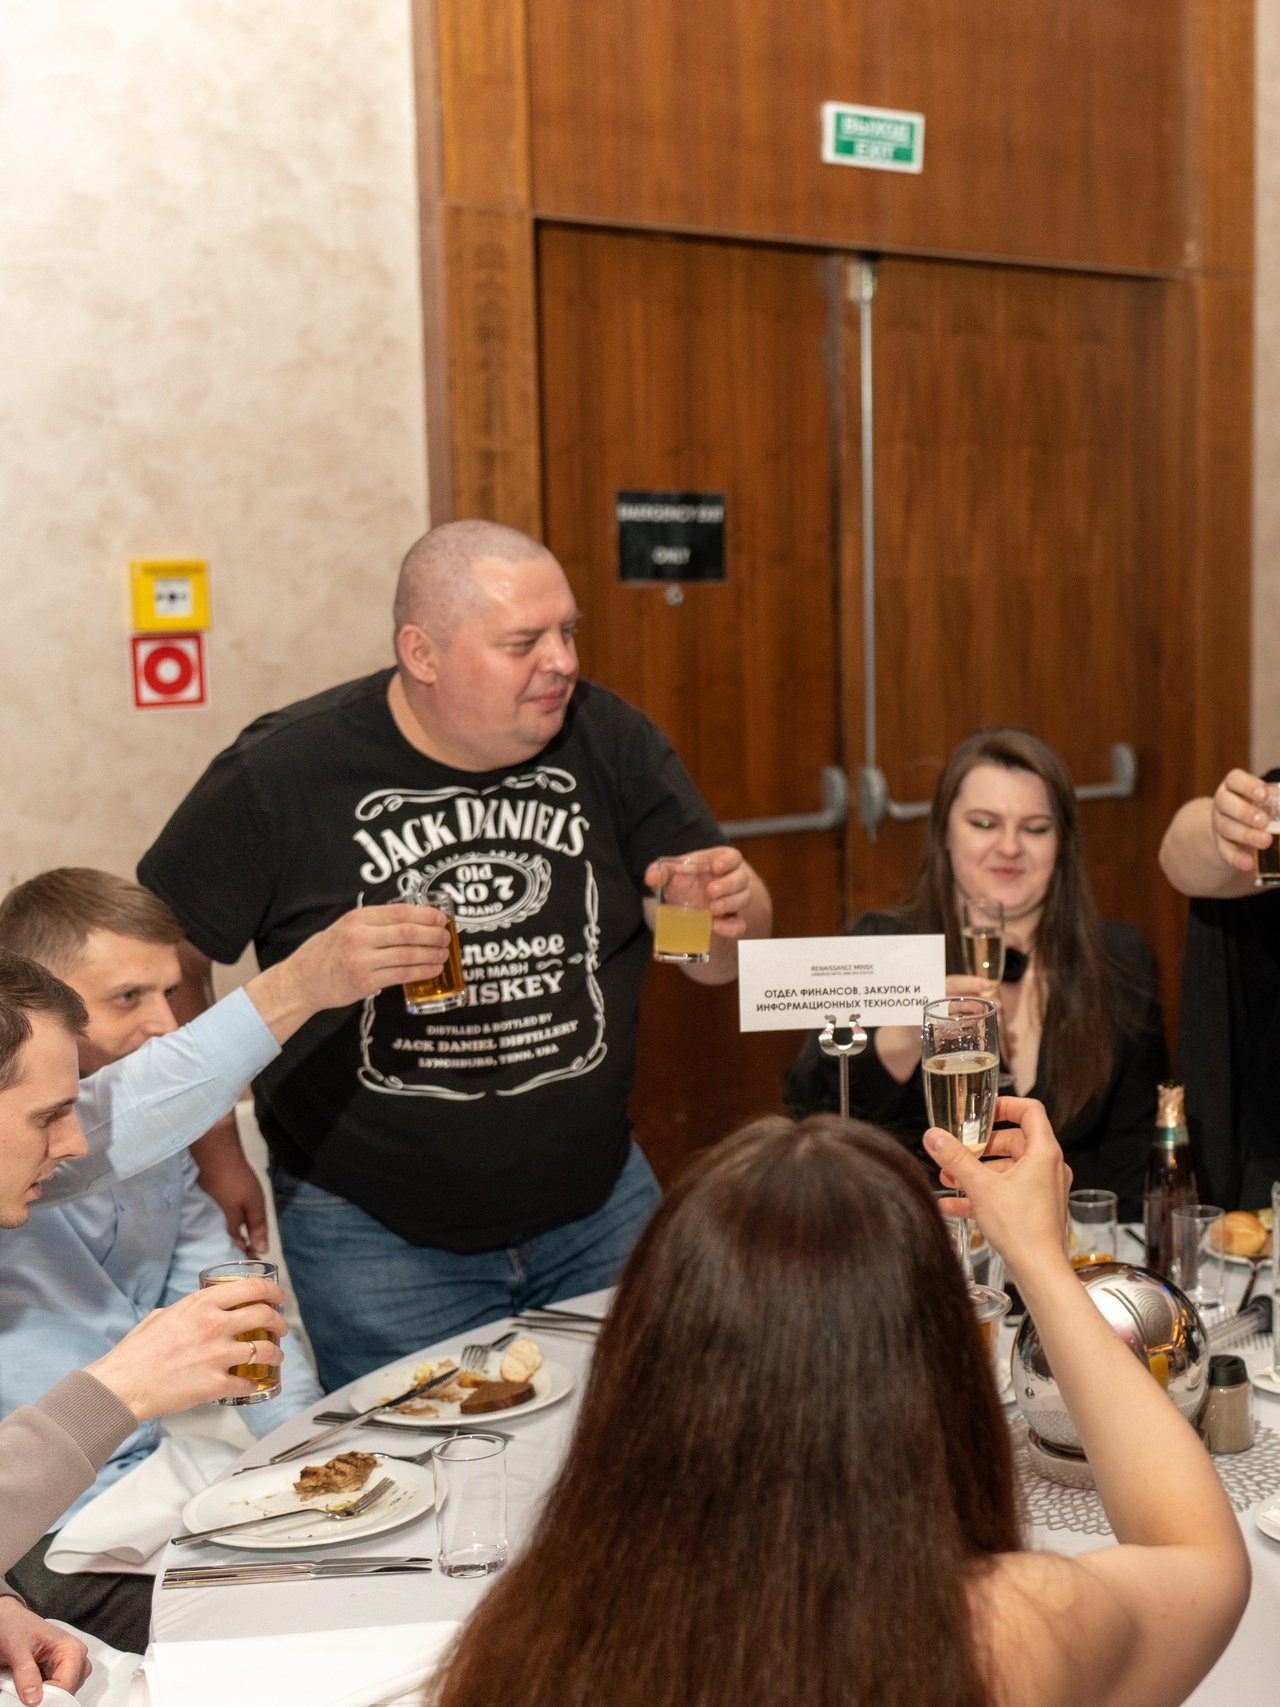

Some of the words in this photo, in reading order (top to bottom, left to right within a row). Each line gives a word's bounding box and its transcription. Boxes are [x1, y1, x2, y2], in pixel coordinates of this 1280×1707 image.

[353, 811, 457, 884] JACK
[455, 798, 590, 857] DANIEL'S
[456, 863, 493, 882] Old
[492, 875, 514, 900] 7
[457, 902, 503, 916] BRAND
[461, 933, 565, 966] nessee
[464, 967, 486, 982] UR
[486, 961, 529, 978] MASH
[467, 969, 565, 1007] ISKEY
[764, 989, 798, 999] ОТДЕЛ
[800, 986, 861, 997] ФИНАНСОВ,
[864, 985, 911, 995] ЗАКУПОК
[914, 985, 921, 994] И
[756, 999, 861, 1012] ИНФОРМАЦИОННЫХ
[864, 996, 929, 1008] ТЕХНОЛОГИЙ
[392, 1038, 435, 1051] JACK
[437, 1038, 497, 1053] DANIEL
[498, 1019, 579, 1049] DISTILLERY
[426, 1024, 481, 1036] DISTILLED
[482, 1025, 492, 1034] &
[492, 1015, 538, 1032] BOTTLED
[538, 1012, 553, 1024] BY
[418, 1056, 498, 1069] LYNCHBURG,
[498, 1050, 535, 1065] TENN.
[534, 1043, 560, 1058] USA
